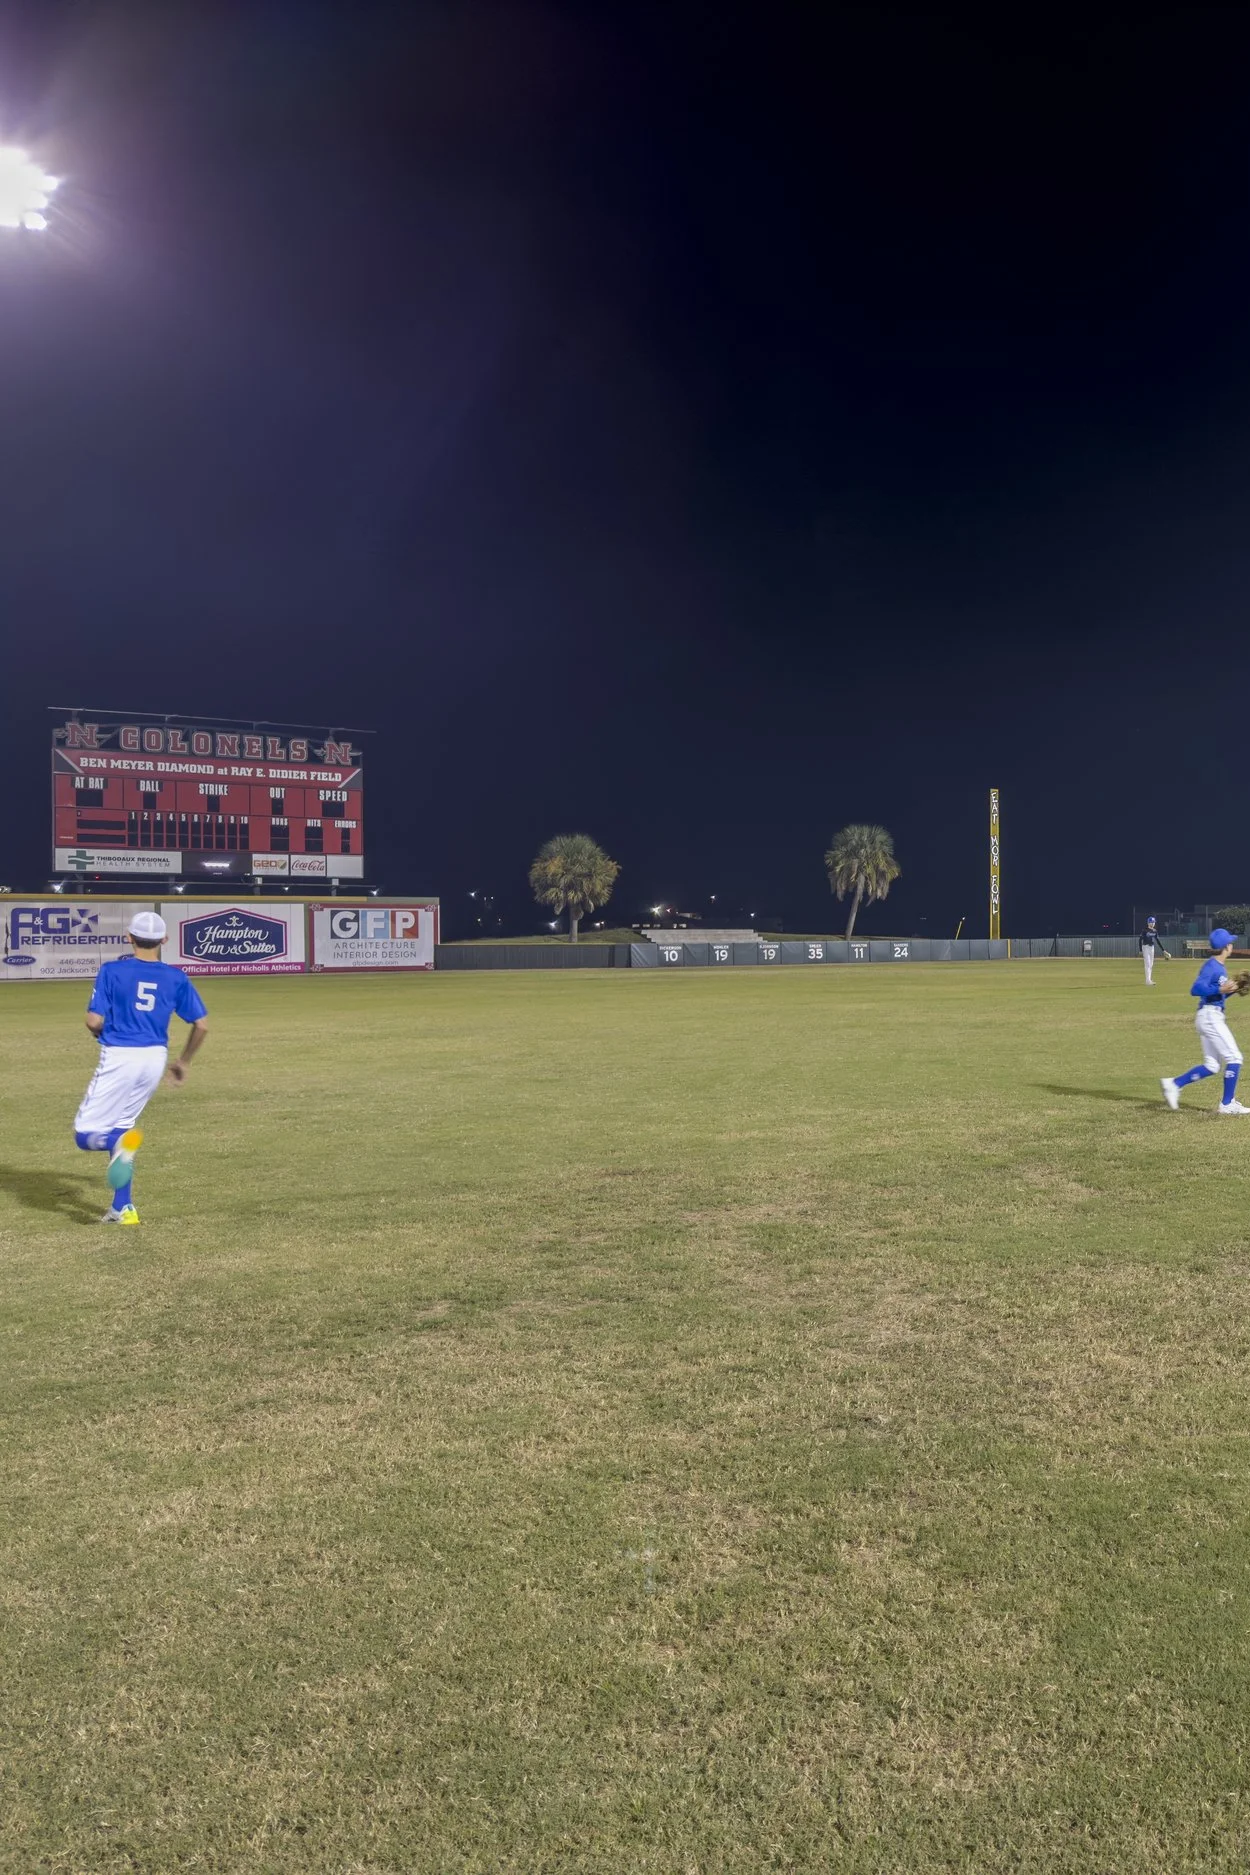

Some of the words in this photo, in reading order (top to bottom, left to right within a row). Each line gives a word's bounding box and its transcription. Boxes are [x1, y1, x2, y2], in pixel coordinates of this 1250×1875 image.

[120, 726, 308, 762] COLONELS
[80, 757, 106, 768] BEN
[110, 759, 154, 771] MEYER
[157, 762, 214, 774] DIAMOND
[217, 767, 228, 775] at
[231, 766, 253, 777] RAY
[256, 769, 266, 777] E.
[269, 769, 307, 780] DIDIER
[310, 771, 342, 782] FIELD
[74, 777, 84, 788] AT
[89, 777, 105, 790] BAT
[140, 780, 160, 792] BALL
[199, 783, 228, 796] STRIKE
[269, 787, 286, 799] OUT
[319, 790, 348, 802] SPEED
[991, 875, 999, 915] FOWL
[332, 911, 416, 939] GFP
[196, 925, 269, 942] Hampton
[20, 935, 134, 945] REFRIGERATIO
[193, 941, 231, 956] Inn
[238, 941, 276, 954] Suites
[714, 949, 728, 960] 19
[763, 949, 776, 960] 19
[808, 948, 823, 959] 35
[854, 948, 864, 958] 11
[893, 947, 908, 957] 24
[333, 951, 378, 959] INTERIOR
[664, 950, 678, 961] 10
[182, 965, 208, 973] Official
[241, 964, 269, 972] Nicholls
[135, 981, 157, 1012] 5
